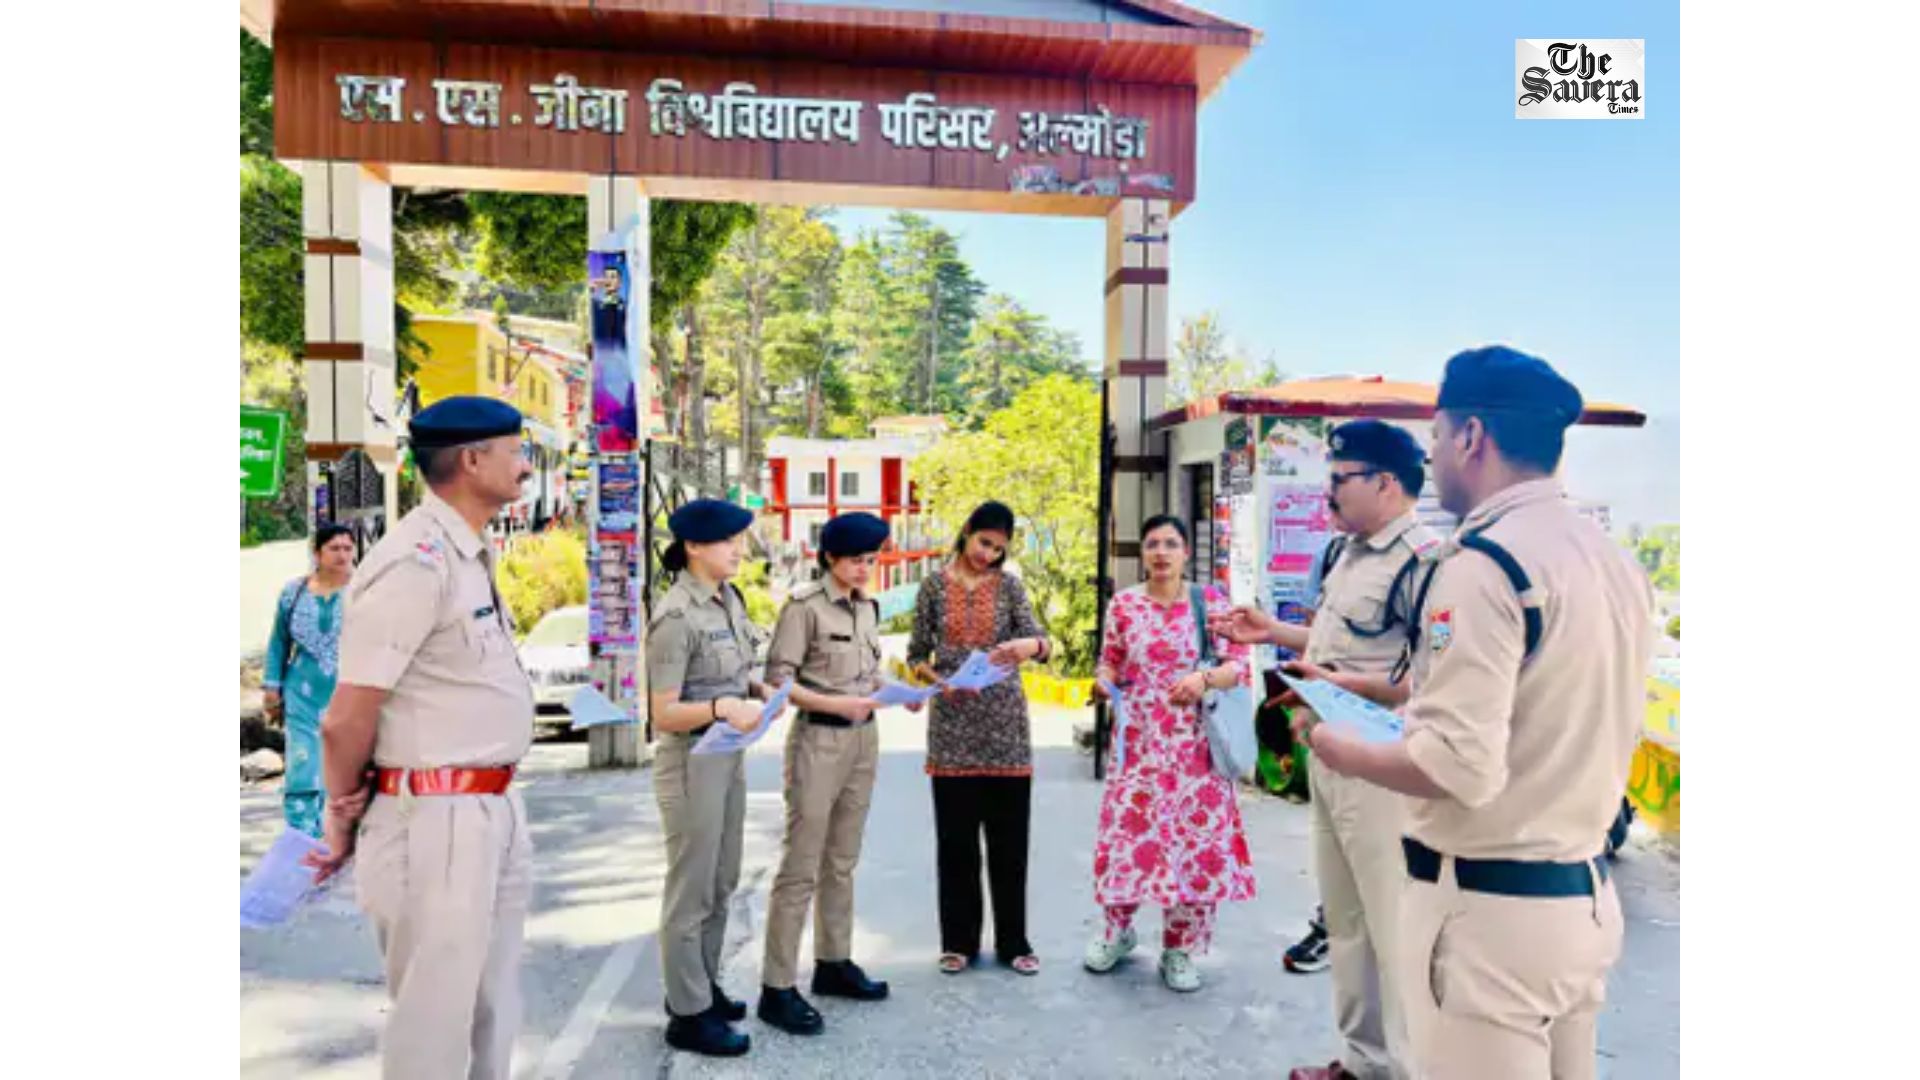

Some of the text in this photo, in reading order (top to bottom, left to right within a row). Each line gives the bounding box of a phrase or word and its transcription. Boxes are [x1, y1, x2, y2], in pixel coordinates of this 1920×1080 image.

[529, 73, 629, 135] जीना
[645, 78, 862, 144] विश्वविद्यालय
[878, 92, 1010, 162] परिसर,
[1018, 103, 1148, 172] अल्मोड़ा
